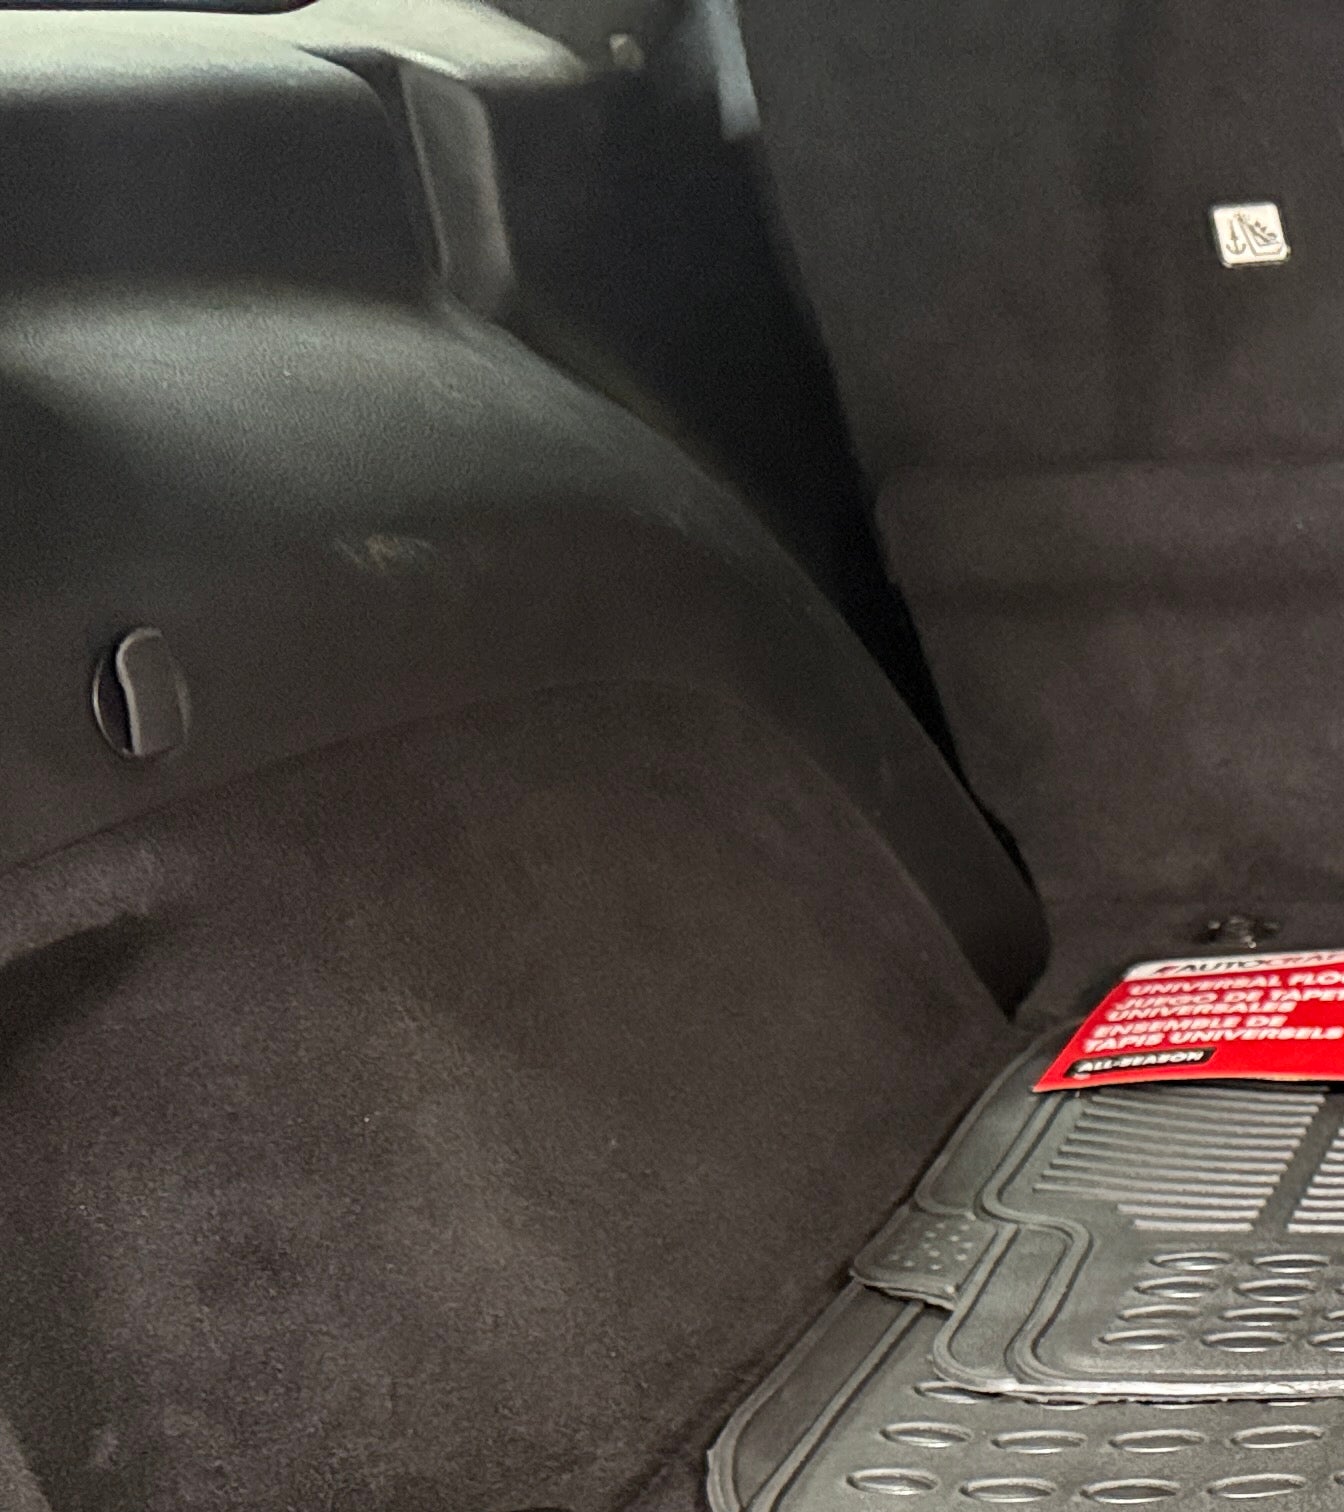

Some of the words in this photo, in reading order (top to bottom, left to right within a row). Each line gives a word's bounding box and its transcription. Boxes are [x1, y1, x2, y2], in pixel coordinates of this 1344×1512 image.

[1128, 974, 1282, 996] UNIVERSAL
[1104, 1000, 1298, 1022] UNIVERSALES
[1114, 993, 1218, 1012] JUEGO
[1223, 989, 1265, 1003] DE
[1092, 1016, 1243, 1039] ENSEMBLE
[1245, 1014, 1288, 1028] DE
[1083, 1032, 1166, 1054] TAPIS
[1078, 1050, 1206, 1073] ALL-SEASON
